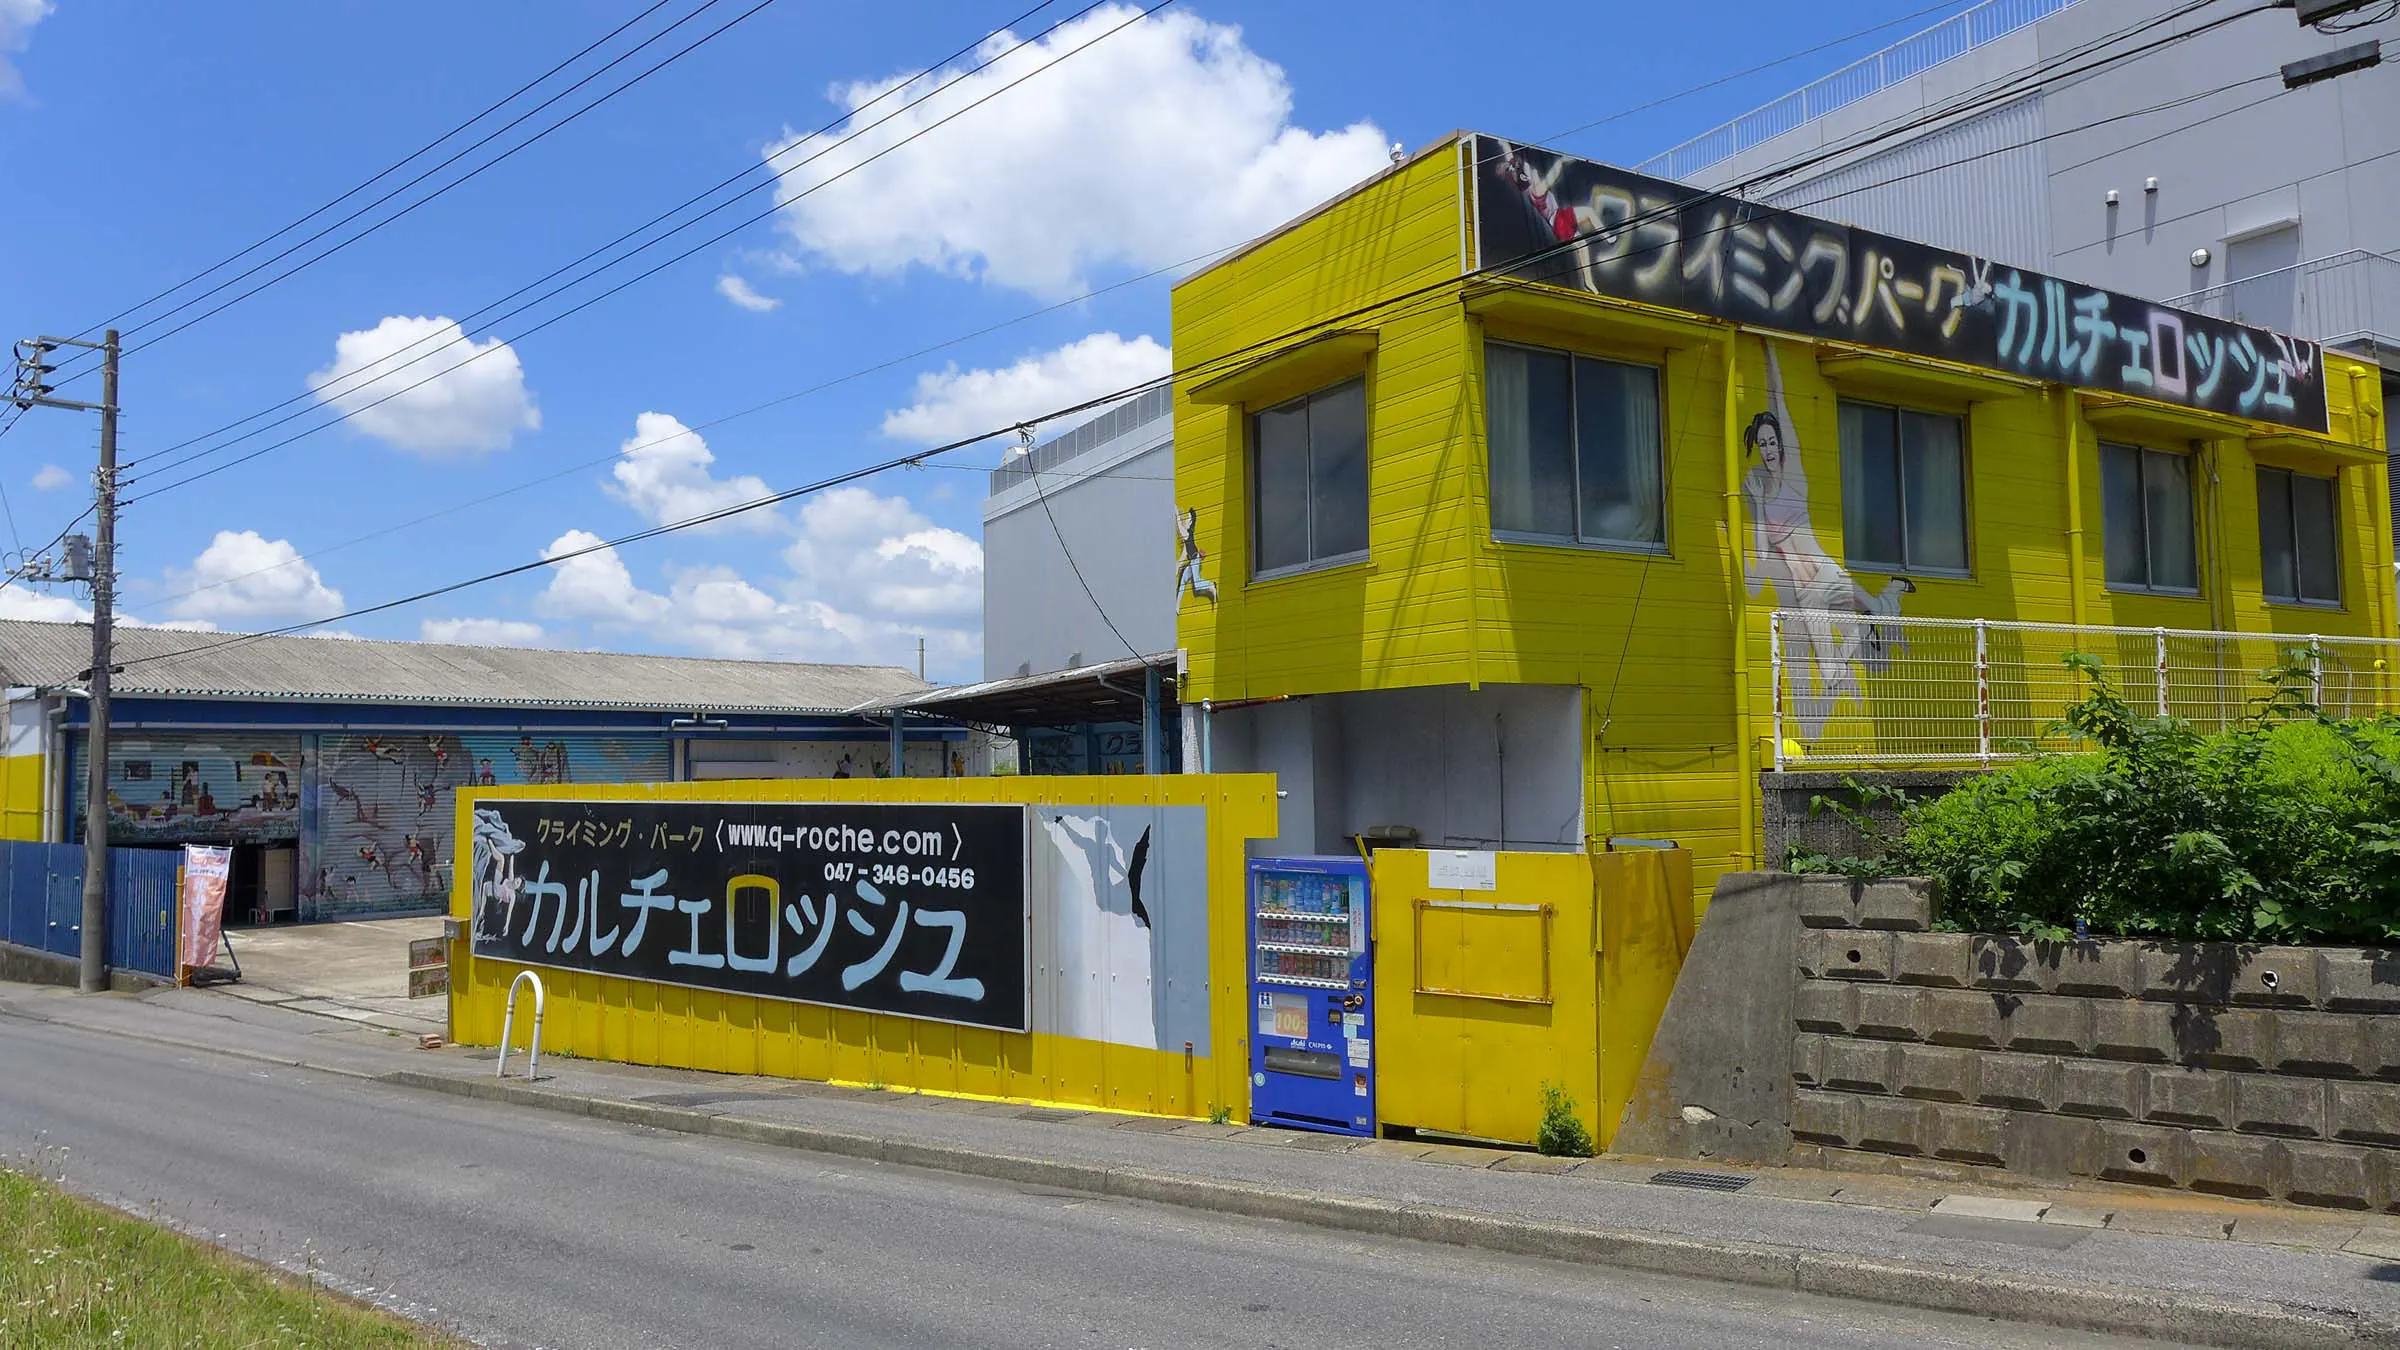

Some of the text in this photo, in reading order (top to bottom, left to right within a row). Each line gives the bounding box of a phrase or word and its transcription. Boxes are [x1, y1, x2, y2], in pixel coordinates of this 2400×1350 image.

[824, 862, 975, 889] 047-346-0456
[521, 859, 985, 1001] カルチェロッシュ
